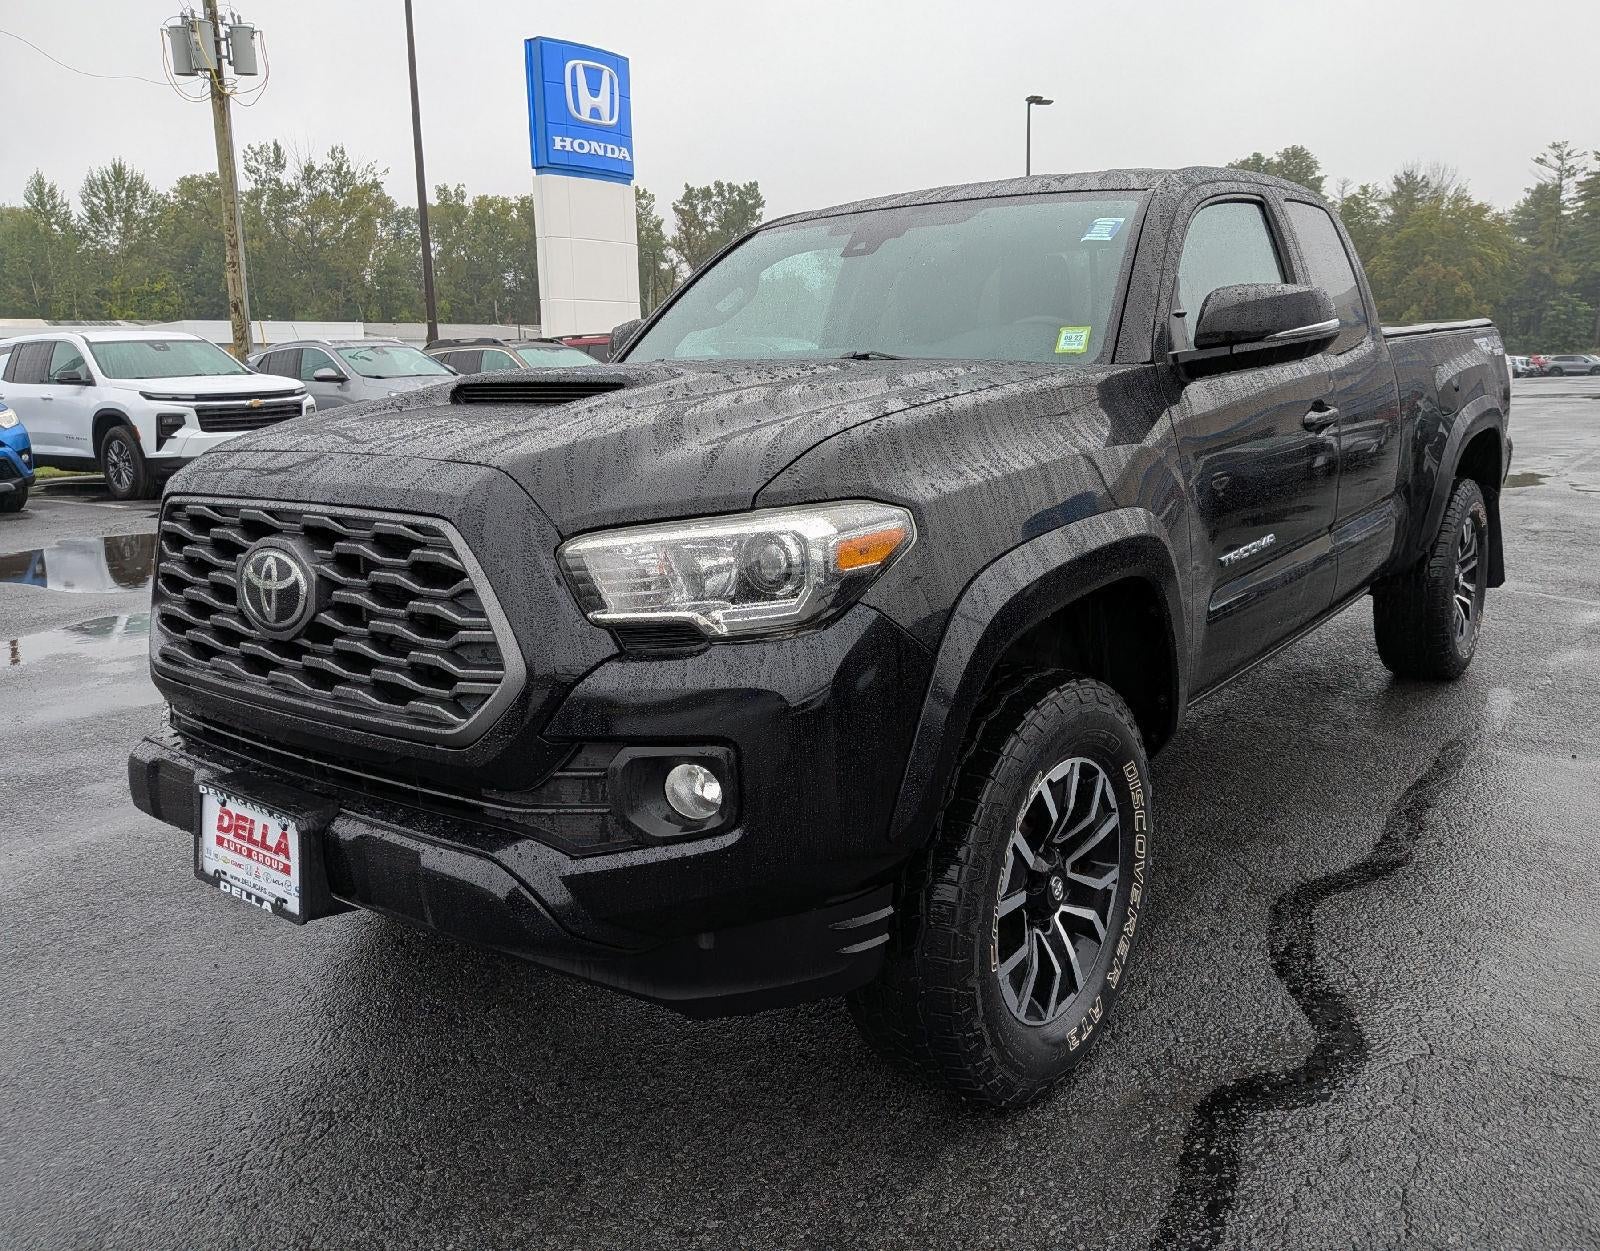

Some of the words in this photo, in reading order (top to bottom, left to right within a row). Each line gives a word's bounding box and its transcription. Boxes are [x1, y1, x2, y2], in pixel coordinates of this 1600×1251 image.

[552, 136, 632, 162] HONDA
[1217, 533, 1276, 566] TACOMA
[216, 807, 290, 860] DELLA
[223, 840, 247, 855] AUTO
[252, 850, 284, 871] GROUP
[1107, 760, 1147, 989] DISCOVERER
[220, 881, 273, 912] DELLA
[1066, 995, 1103, 1051] AT3
